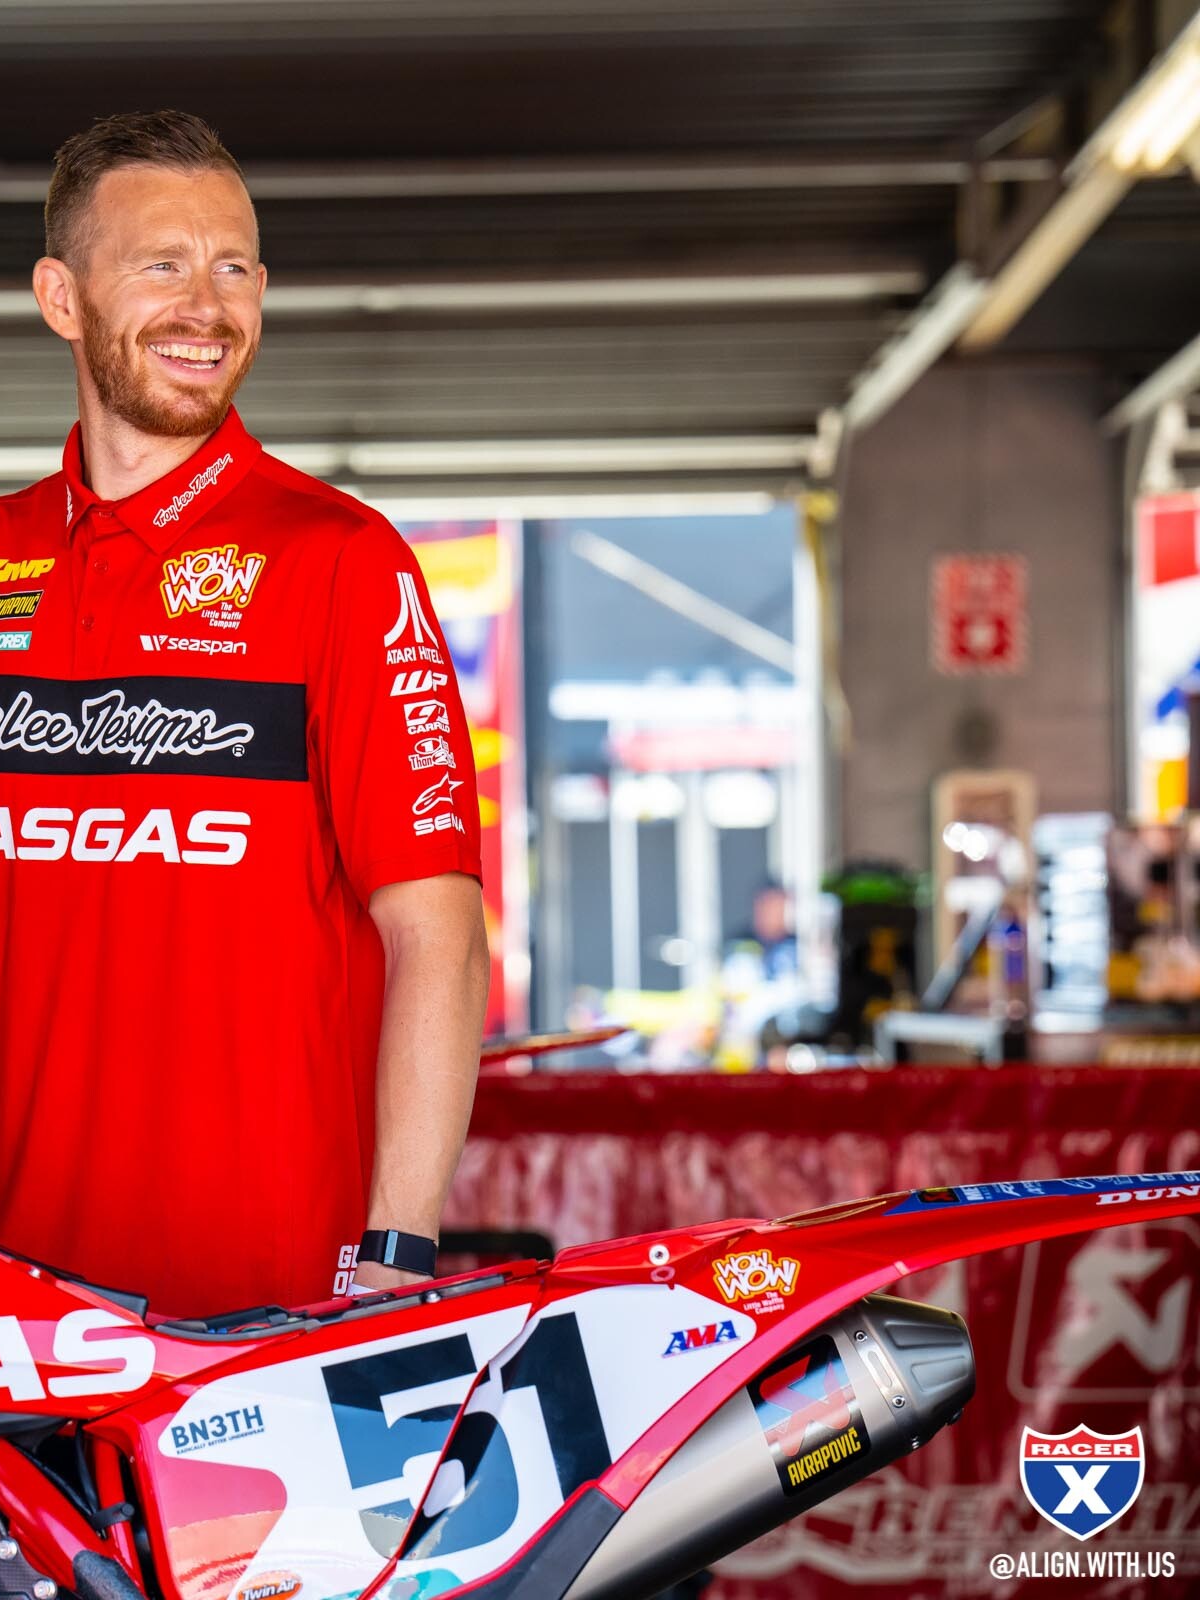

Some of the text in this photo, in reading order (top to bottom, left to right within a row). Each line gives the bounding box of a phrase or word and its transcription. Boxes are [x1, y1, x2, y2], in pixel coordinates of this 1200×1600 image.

[153, 453, 231, 527] Troy Lee Designs
[167, 548, 233, 586] WOW
[164, 557, 262, 614] WOW!
[201, 610, 242, 620] Little Waffle
[221, 602, 232, 611] The
[209, 619, 240, 630] Company
[167, 637, 247, 655] seaspan
[386, 647, 417, 665] ATARI
[76, 689, 255, 765] Designs
[408, 754, 433, 770] Than
[1096, 1185, 1200, 1205] DUN
[716, 1251, 768, 1279] WOW
[717, 1259, 797, 1300] WOW!
[662, 1320, 738, 1356] AMA
[171, 1404, 263, 1448] BN3TH
[321, 1311, 613, 1561] 51
[243, 1579, 296, 1600] Twin Air
